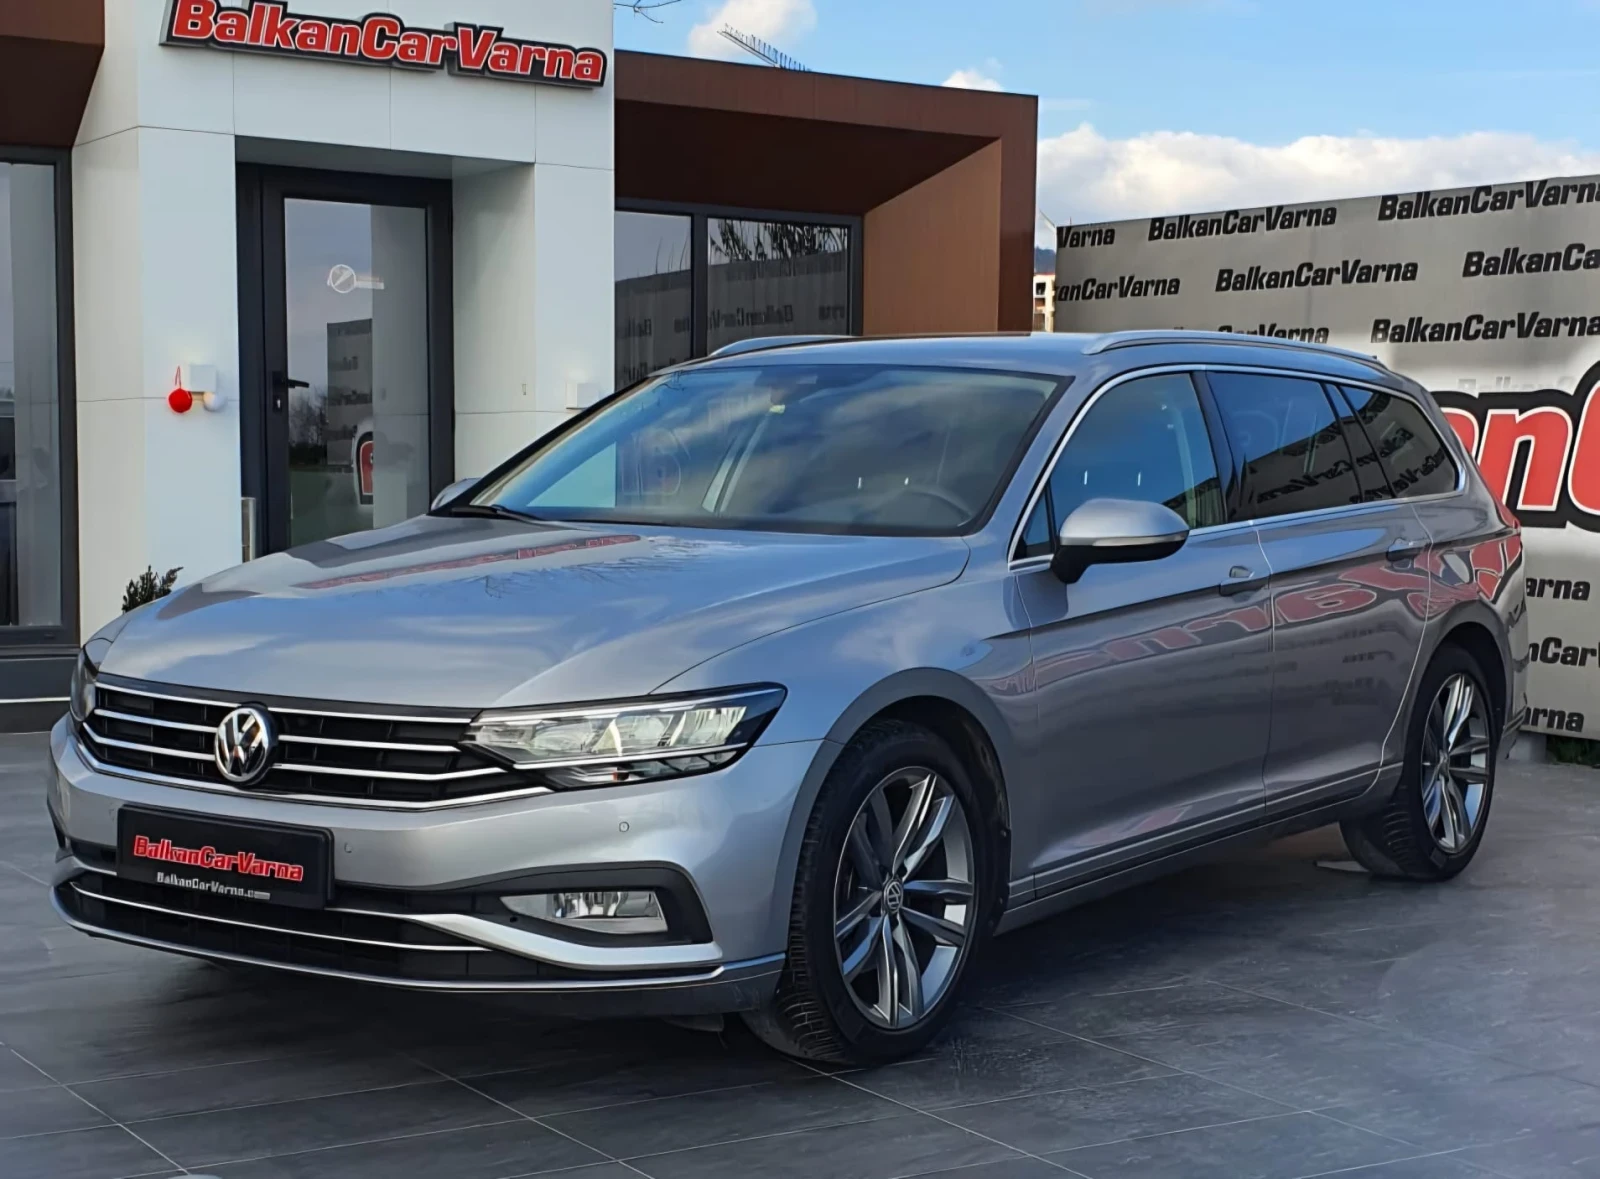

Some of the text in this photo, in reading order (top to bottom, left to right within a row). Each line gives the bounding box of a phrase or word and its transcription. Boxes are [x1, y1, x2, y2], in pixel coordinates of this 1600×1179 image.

[172, 0, 603, 82] BalkanCarVarna
[1148, 207, 1337, 241] BalkanCarVarna
[1215, 259, 1418, 292] BalkanCarVarna
[1371, 312, 1600, 343] BalkanCarVarna
[134, 835, 303, 881] BalkanCarVarna
[156, 872, 270, 899] BalkanCarVarna.c
